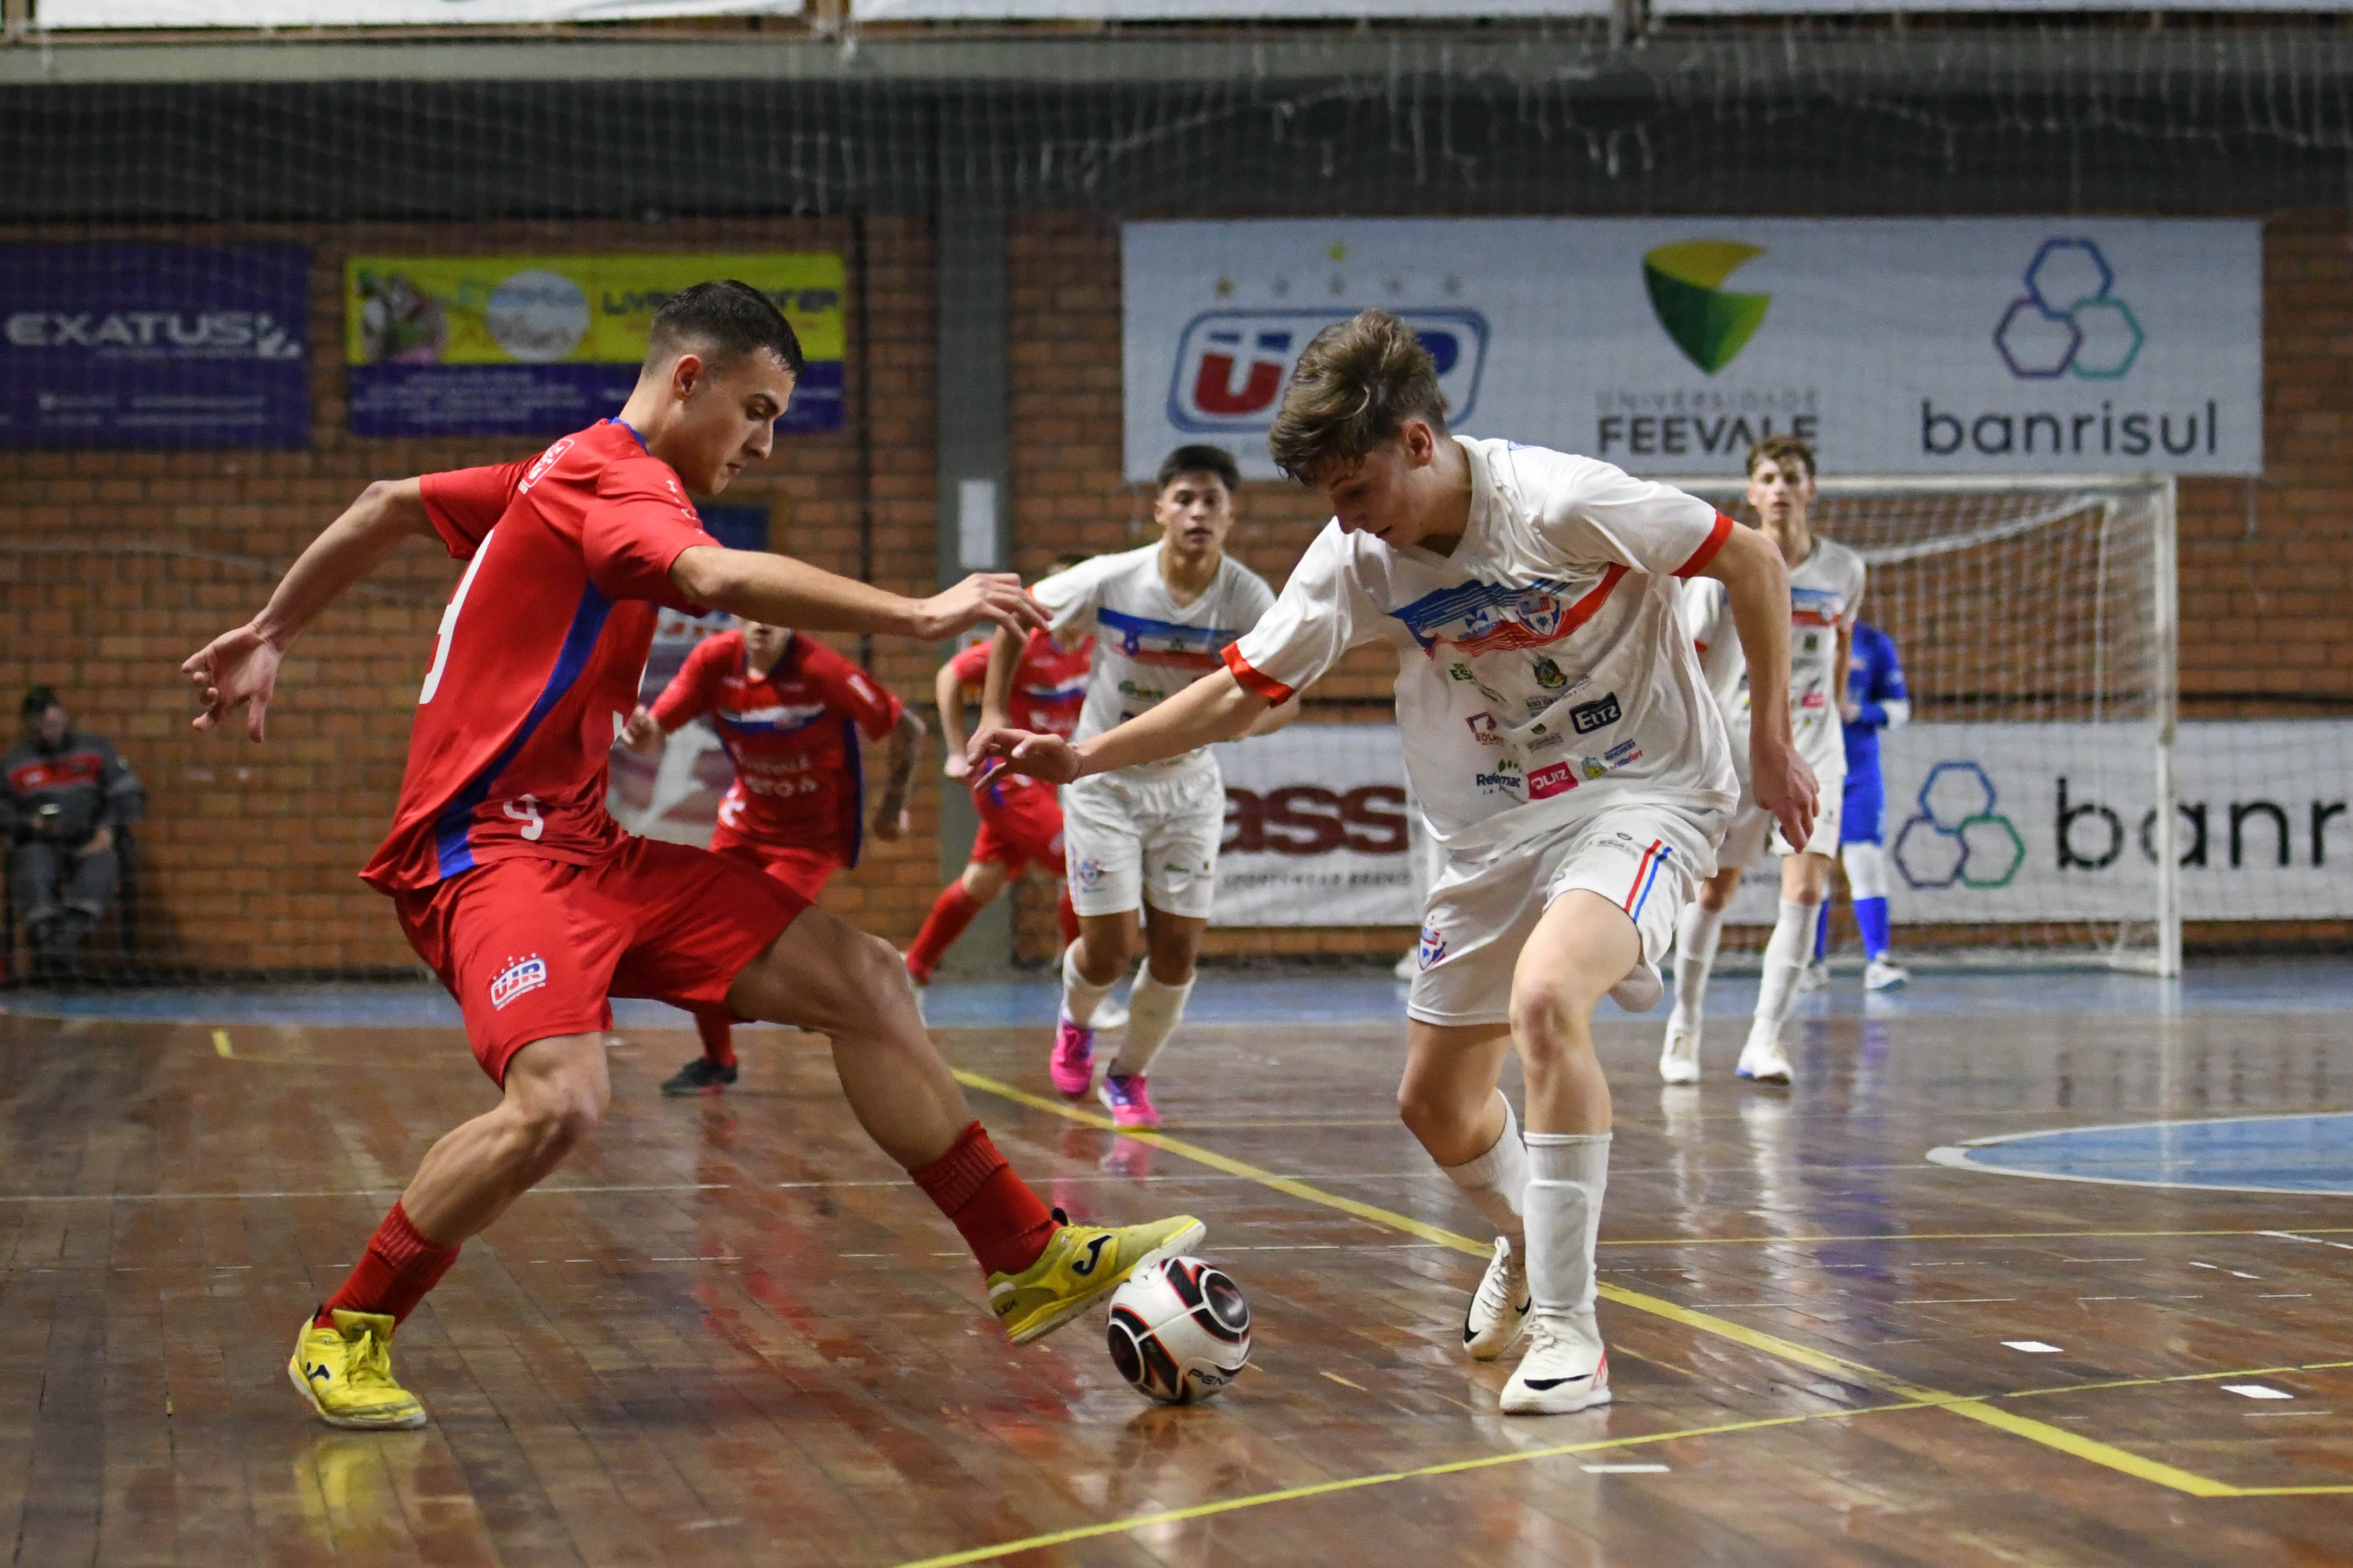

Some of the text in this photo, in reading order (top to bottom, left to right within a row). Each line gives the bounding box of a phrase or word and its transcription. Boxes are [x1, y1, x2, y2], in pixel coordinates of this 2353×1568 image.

[5, 312, 256, 346] EXATUS
[1596, 387, 1816, 410] UNIVERSIDADE
[1921, 398, 2217, 456] banrisul
[1531, 769, 1569, 791] QUIZ
[503, 793, 544, 841] 9
